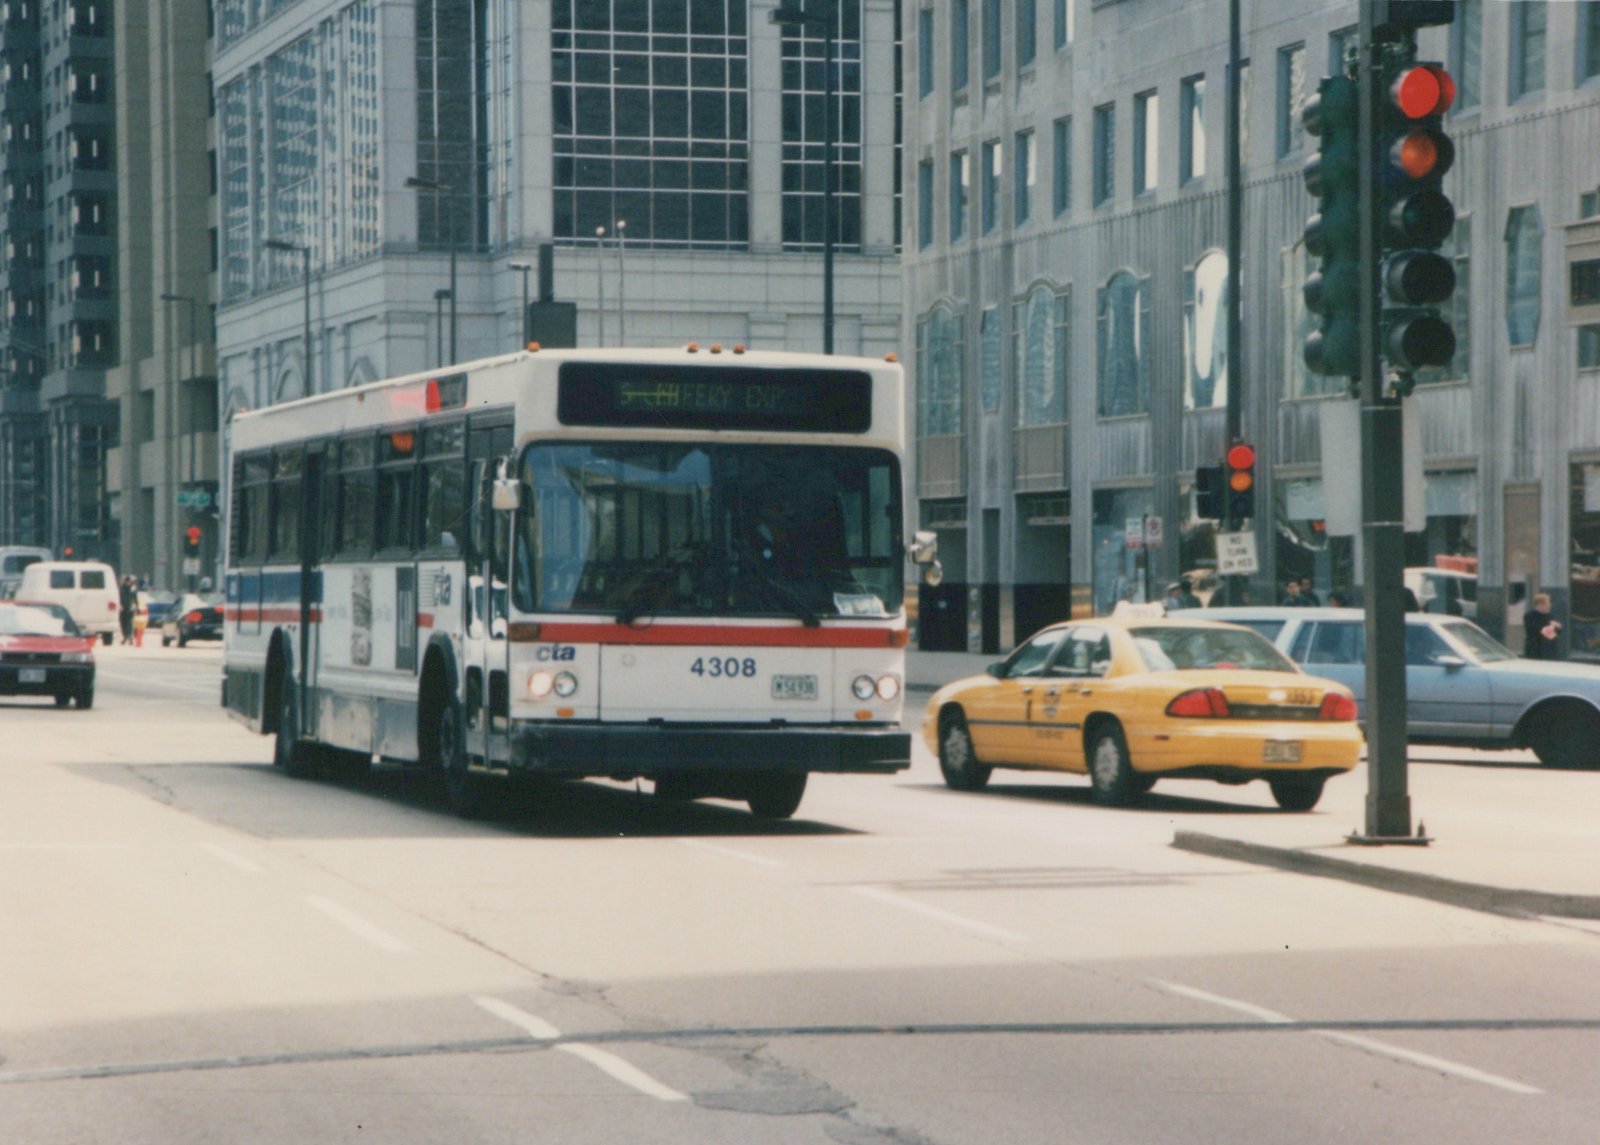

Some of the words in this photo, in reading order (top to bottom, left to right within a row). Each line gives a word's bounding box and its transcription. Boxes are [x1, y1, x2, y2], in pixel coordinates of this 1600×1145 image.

[1230, 536, 1242, 544] NO
[1227, 547, 1247, 557] TURN
[1223, 560, 1234, 569] ON
[1237, 558, 1253, 567] RED
[432, 566, 451, 607] cta
[536, 642, 576, 662] cta
[690, 656, 757, 678] 4308
